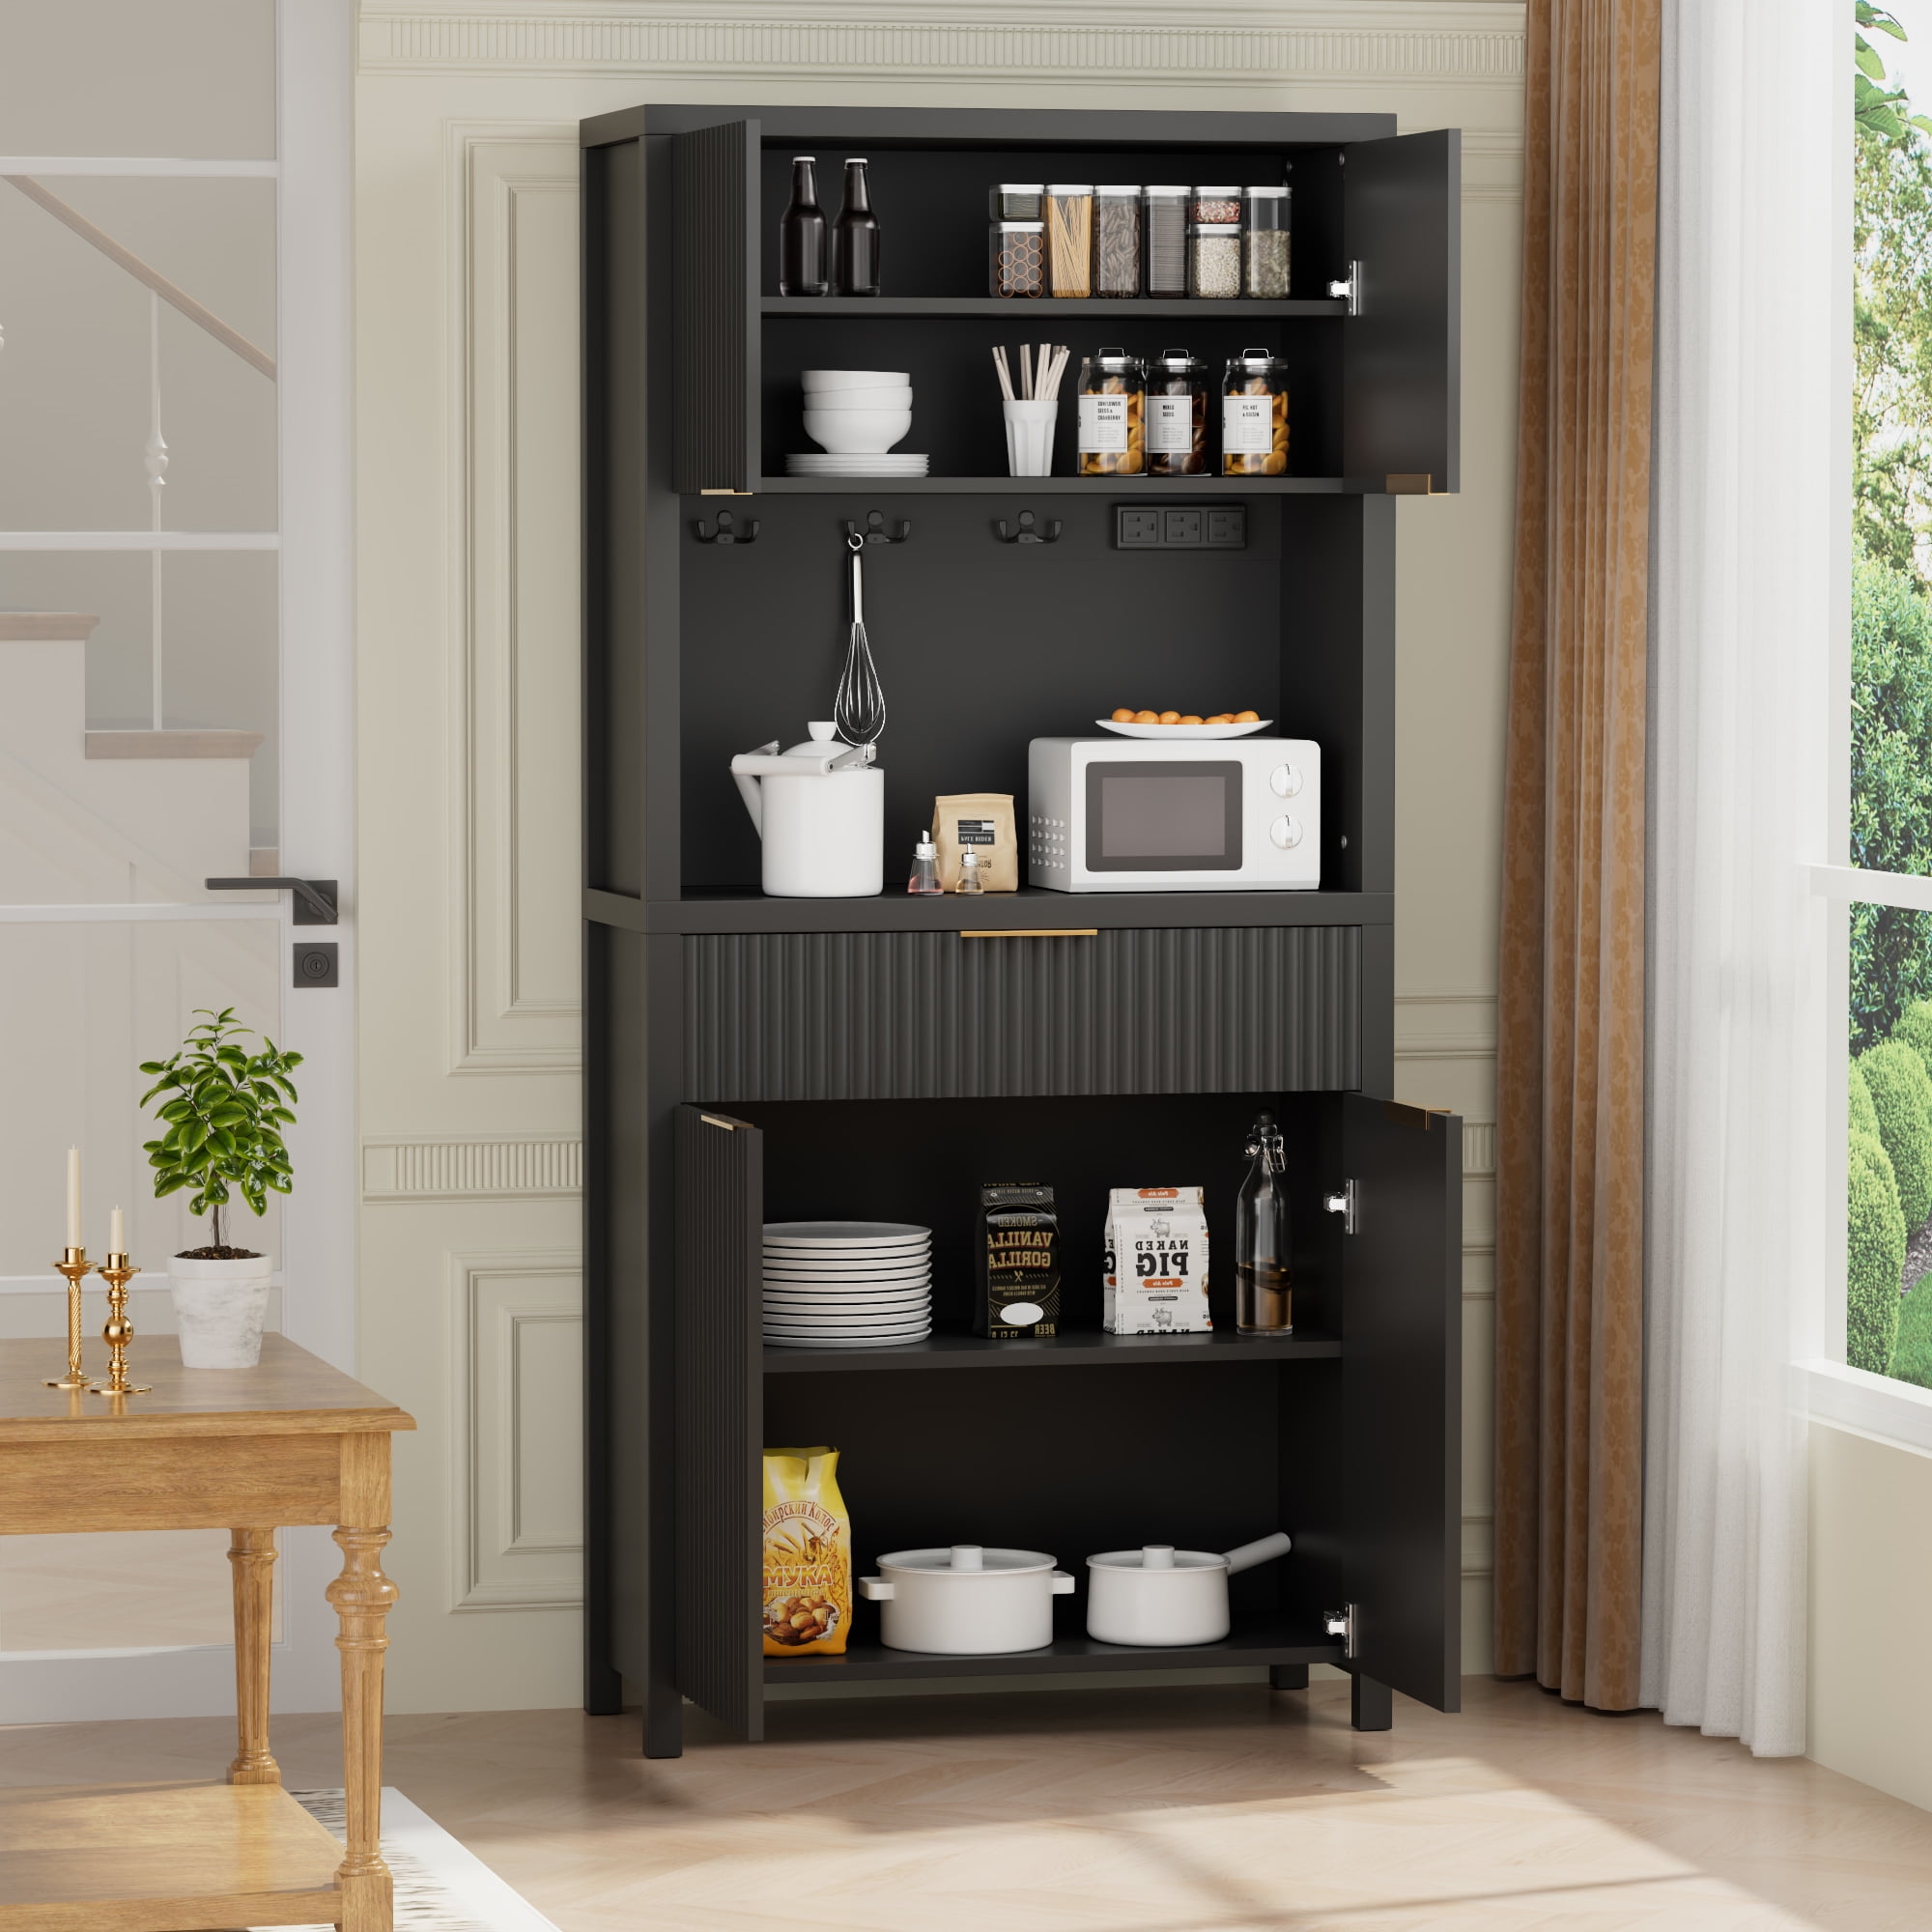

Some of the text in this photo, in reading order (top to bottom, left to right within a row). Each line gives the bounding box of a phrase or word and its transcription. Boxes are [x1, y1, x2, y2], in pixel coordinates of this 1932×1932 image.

[763, 1502, 835, 1533] ибирский Колос
[763, 1565, 833, 1587] МУКА
